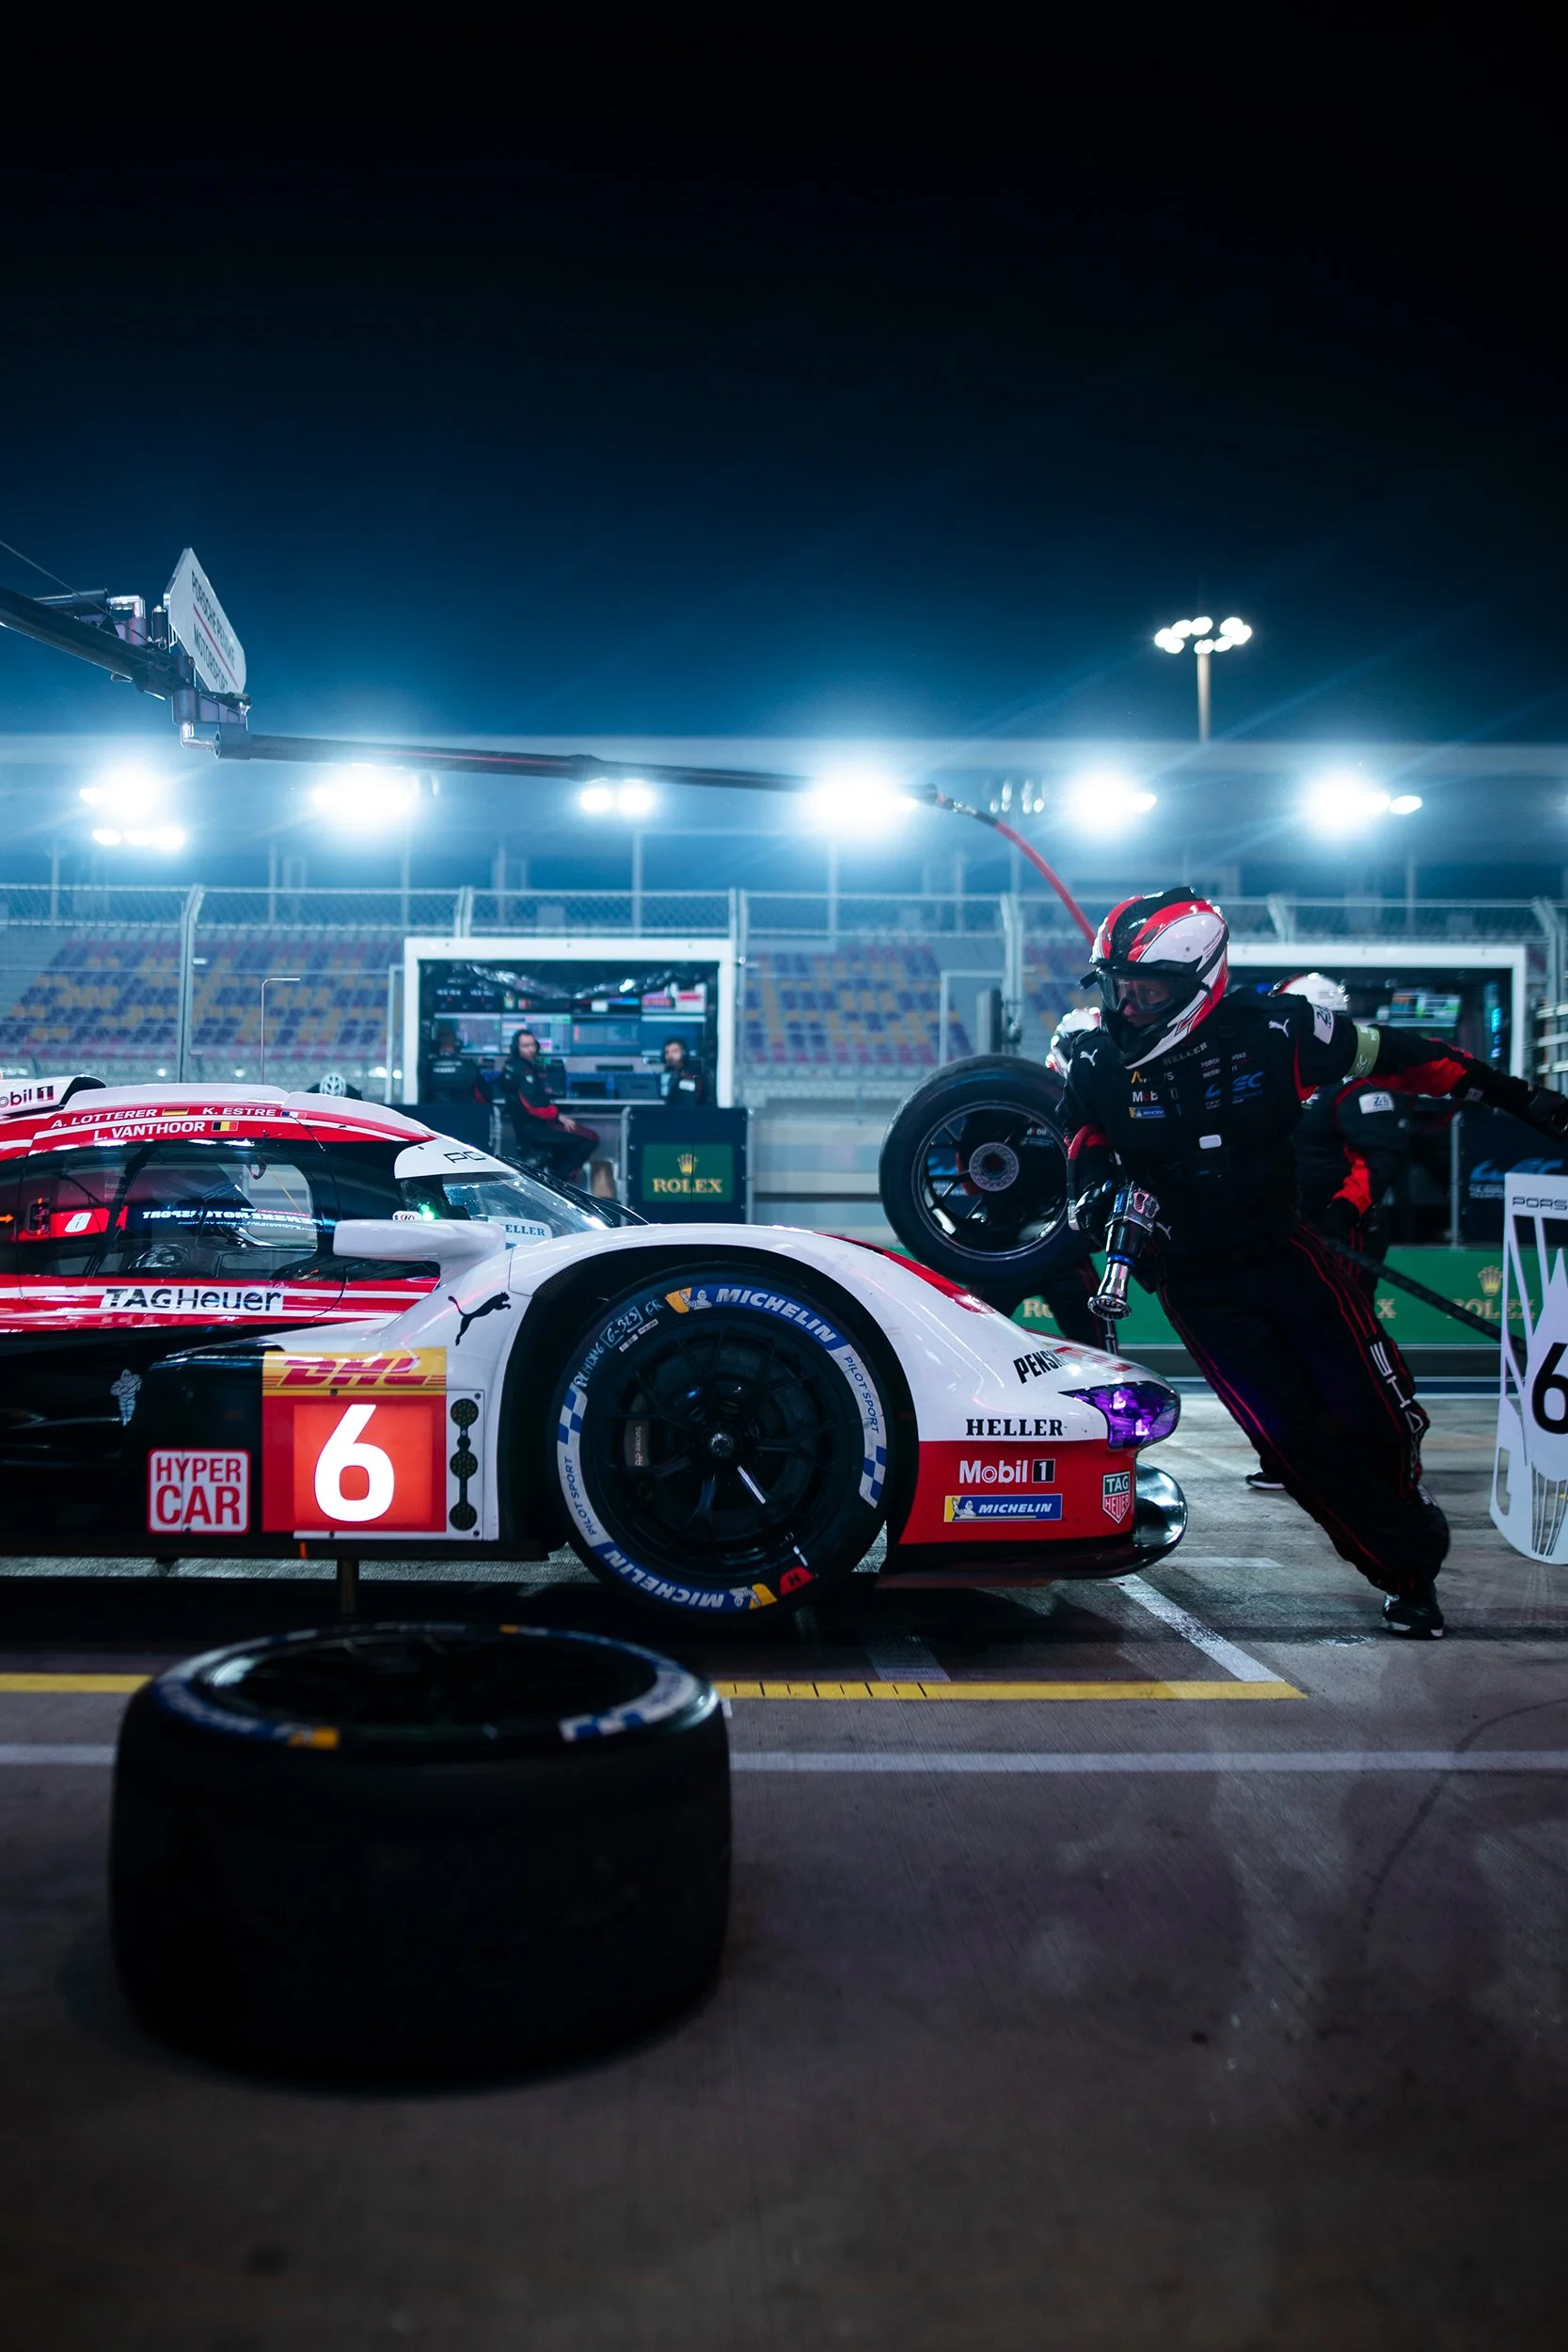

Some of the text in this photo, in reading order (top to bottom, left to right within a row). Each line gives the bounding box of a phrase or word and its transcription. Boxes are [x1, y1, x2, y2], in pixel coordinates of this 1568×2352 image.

[0, 1089, 32, 1108] obil
[51, 1108, 158, 1129] A. LOTTERER
[201, 1107, 277, 1118] K. ESTRE
[94, 1121, 206, 1141] L. VANTHOOR
[652, 1178, 722, 1194] ROLEX
[1512, 1197, 1567, 1211] PORS
[504, 1223, 546, 1236] ELLER
[715, 1288, 837, 1343] MICHELIN
[280, 1358, 428, 1386] DHL
[844, 1356, 880, 1435] PILOT SPORT
[1532, 1343, 1568, 1435] 6
[966, 1419, 1063, 1437] HELLER
[156, 1457, 242, 1483] HYPER
[313, 1404, 395, 1522] 6
[959, 1460, 1028, 1484] Mobil
[1106, 1475, 1129, 1492] TAG
[156, 1485, 242, 1526] CAR
[564, 1457, 598, 1536] PILOT SPORT
[978, 1503, 1053, 1514] MICHELIN
[1105, 1494, 1129, 1519] HEUER
[604, 1549, 724, 1609] MICHELIN
